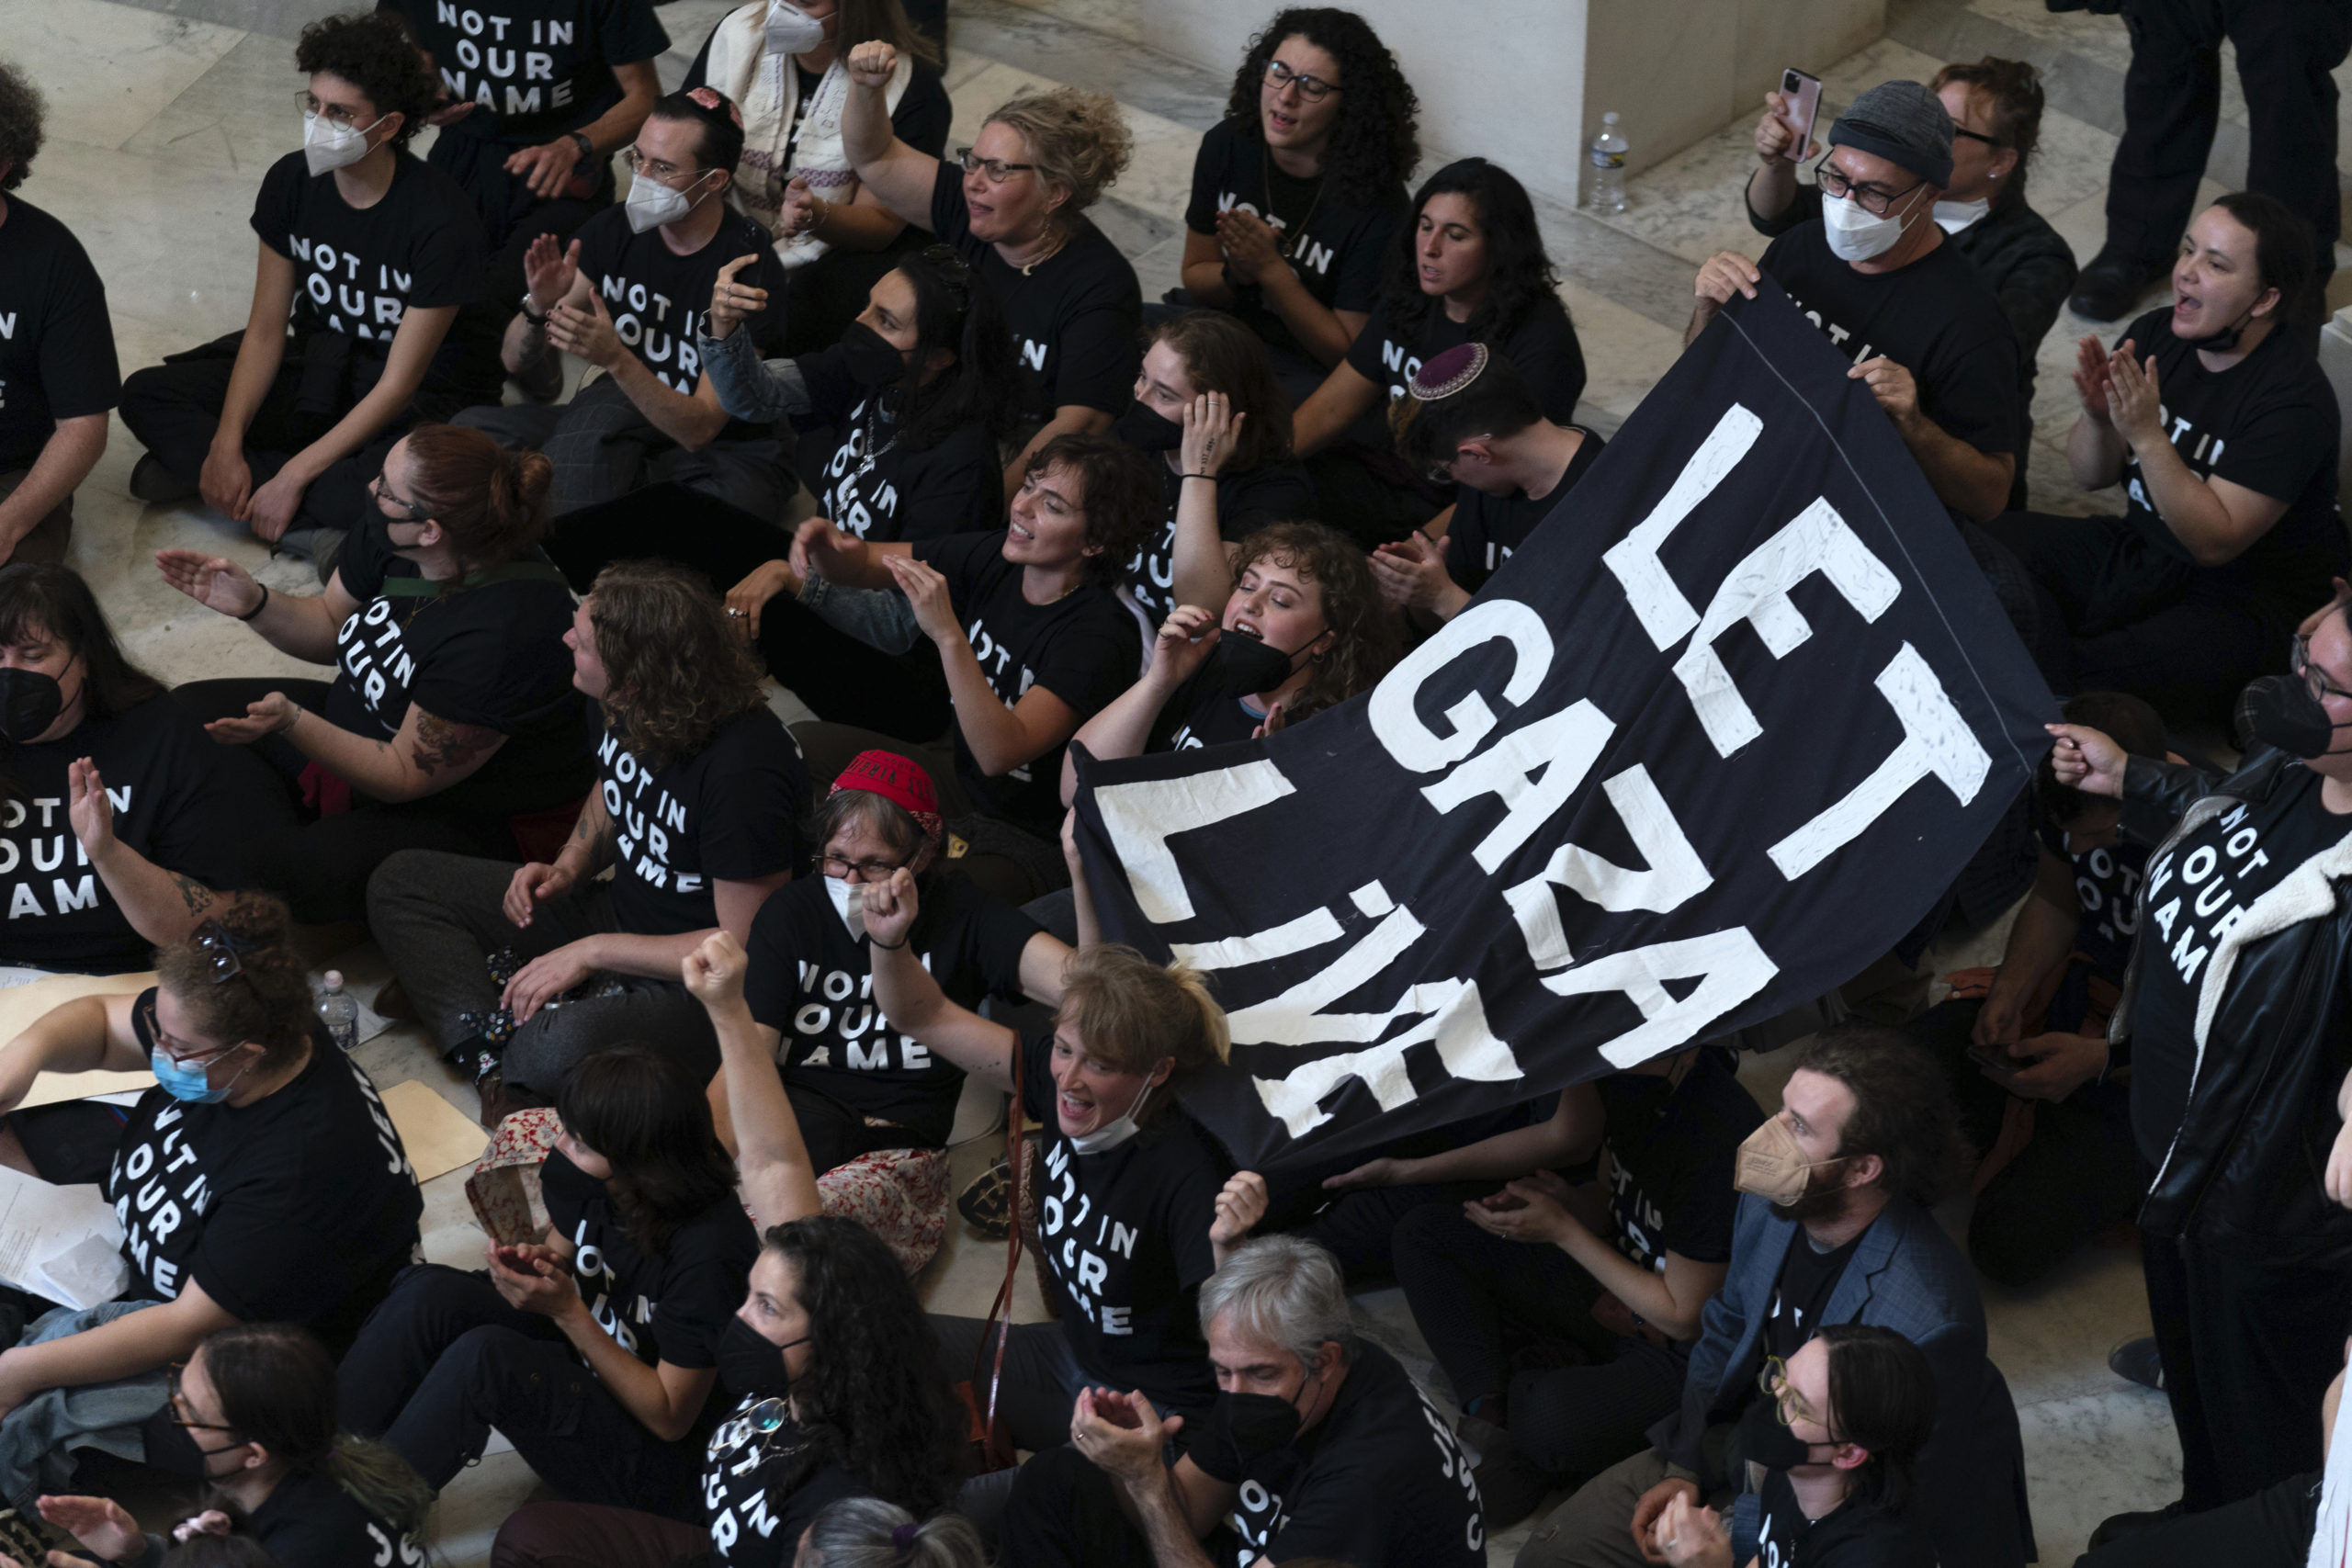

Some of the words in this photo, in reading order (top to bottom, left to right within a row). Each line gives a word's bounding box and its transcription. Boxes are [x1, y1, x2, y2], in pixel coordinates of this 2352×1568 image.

[437, 0, 512, 42] NOT
[532, 19, 574, 46] IN
[457, 38, 553, 81] OUR
[441, 66, 574, 116] NAME
[289, 233, 362, 281] NOT
[1294, 233, 1335, 276] IN
[307, 272, 402, 325] OUR
[602, 274, 672, 321] NOT
[684, 310, 695, 338] I
[615, 312, 700, 378] OUR
[1012, 333, 1048, 372] N
[1381, 338, 1423, 384] NO
[364, 595, 402, 649] OT
[1602, 401, 1993, 882] LET
[337, 612, 387, 712] OUR
[382, 643, 417, 690] IN
[105, 784, 132, 818] N
[596, 730, 654, 801] NOT
[656, 789, 687, 835] IN
[603, 778, 671, 865] OUR
[1367, 598, 1780, 1070] GAZA
[2220, 803, 2271, 880] NOT
[617, 833, 705, 895] AME
[6, 874, 100, 919] AM
[2075, 875, 2139, 936] OU
[2147, 851, 2210, 986] NAM
[2181, 844, 2248, 940] OUR
[125, 1142, 182, 1247] OUR
[1096, 1213, 1139, 1261] IN
[739, 1487, 781, 1540] IN
